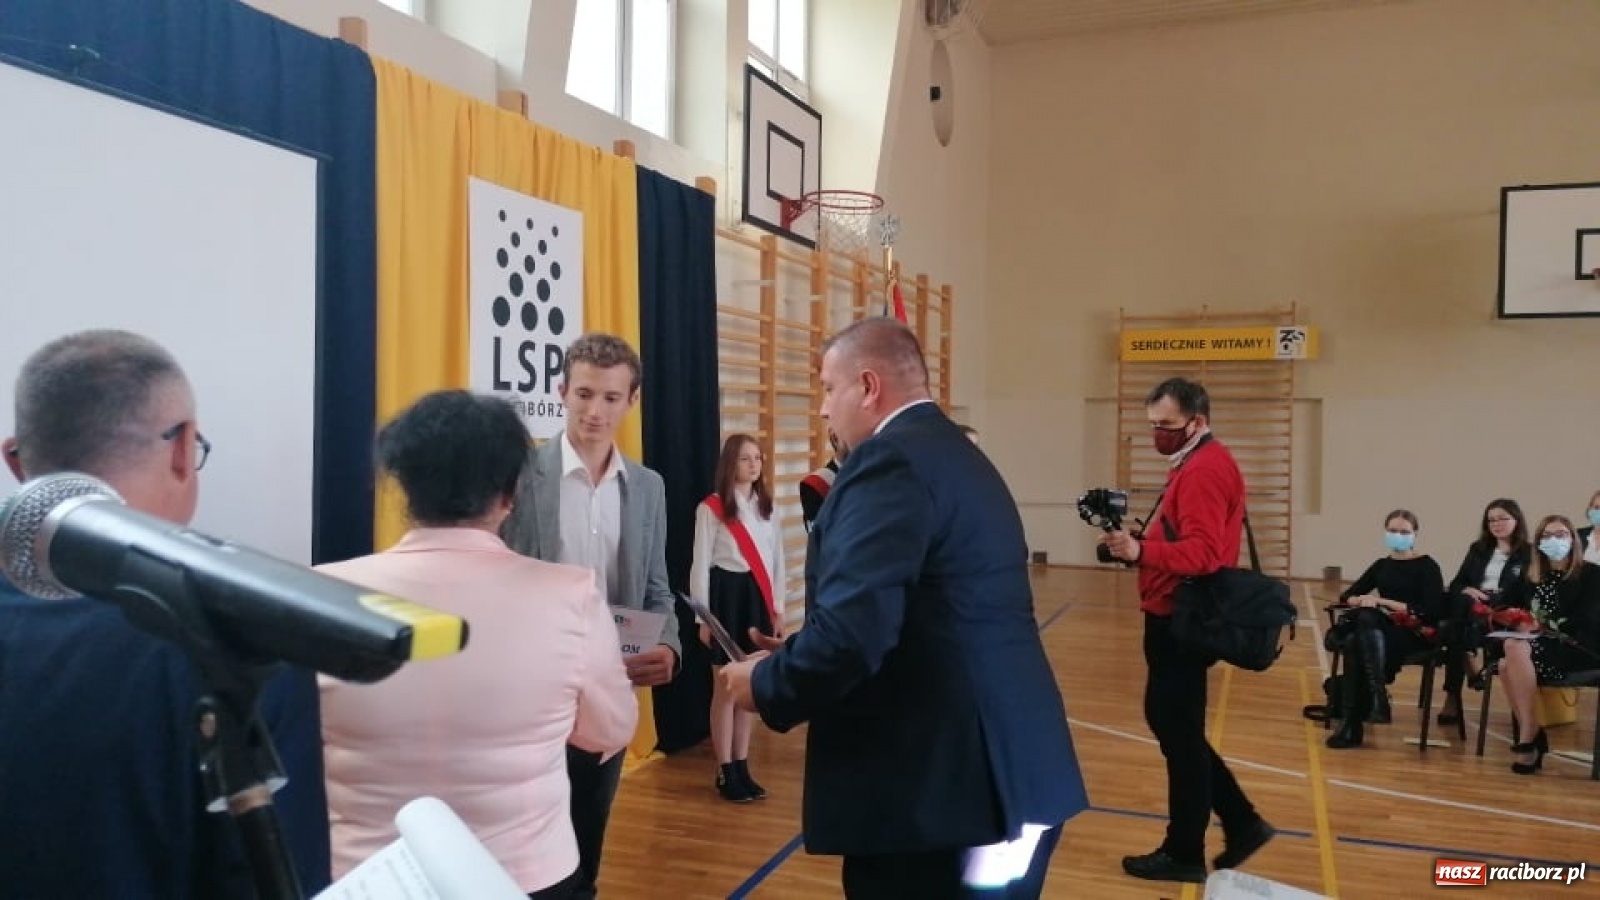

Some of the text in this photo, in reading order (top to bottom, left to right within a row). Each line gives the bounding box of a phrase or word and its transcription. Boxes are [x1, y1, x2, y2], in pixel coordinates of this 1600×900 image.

[1131, 339, 1206, 351] SERDECZNIE
[1211, 337, 1263, 349] WITAMY
[493, 336, 564, 394] LSP
